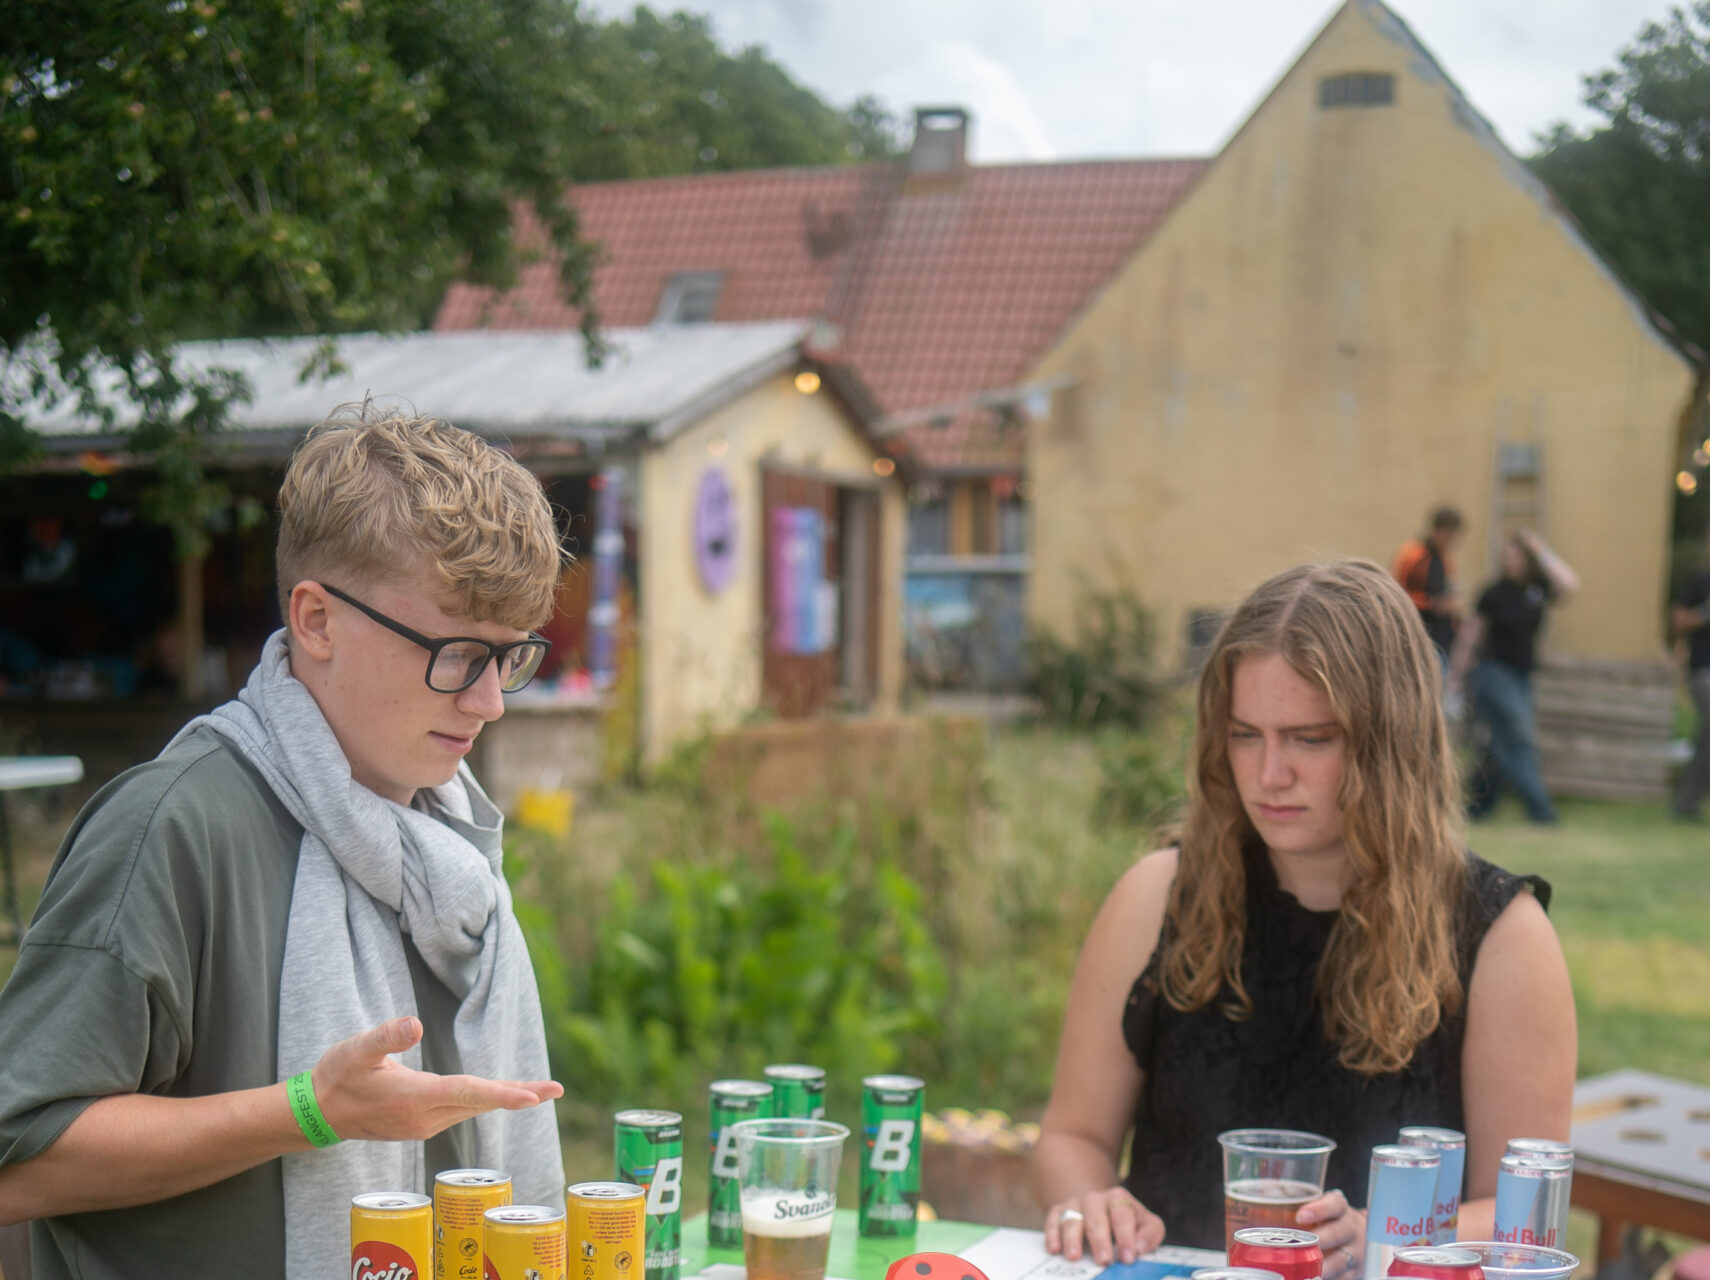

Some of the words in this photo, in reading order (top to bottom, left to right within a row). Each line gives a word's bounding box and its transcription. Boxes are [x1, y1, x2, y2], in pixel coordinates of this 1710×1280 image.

[870, 1119, 916, 1171] B
[646, 1156, 683, 1214] B
[1435, 1195, 1455, 1215] ed
[1386, 1216, 1424, 1236] Red
[1521, 1228, 1557, 1248] Bull
